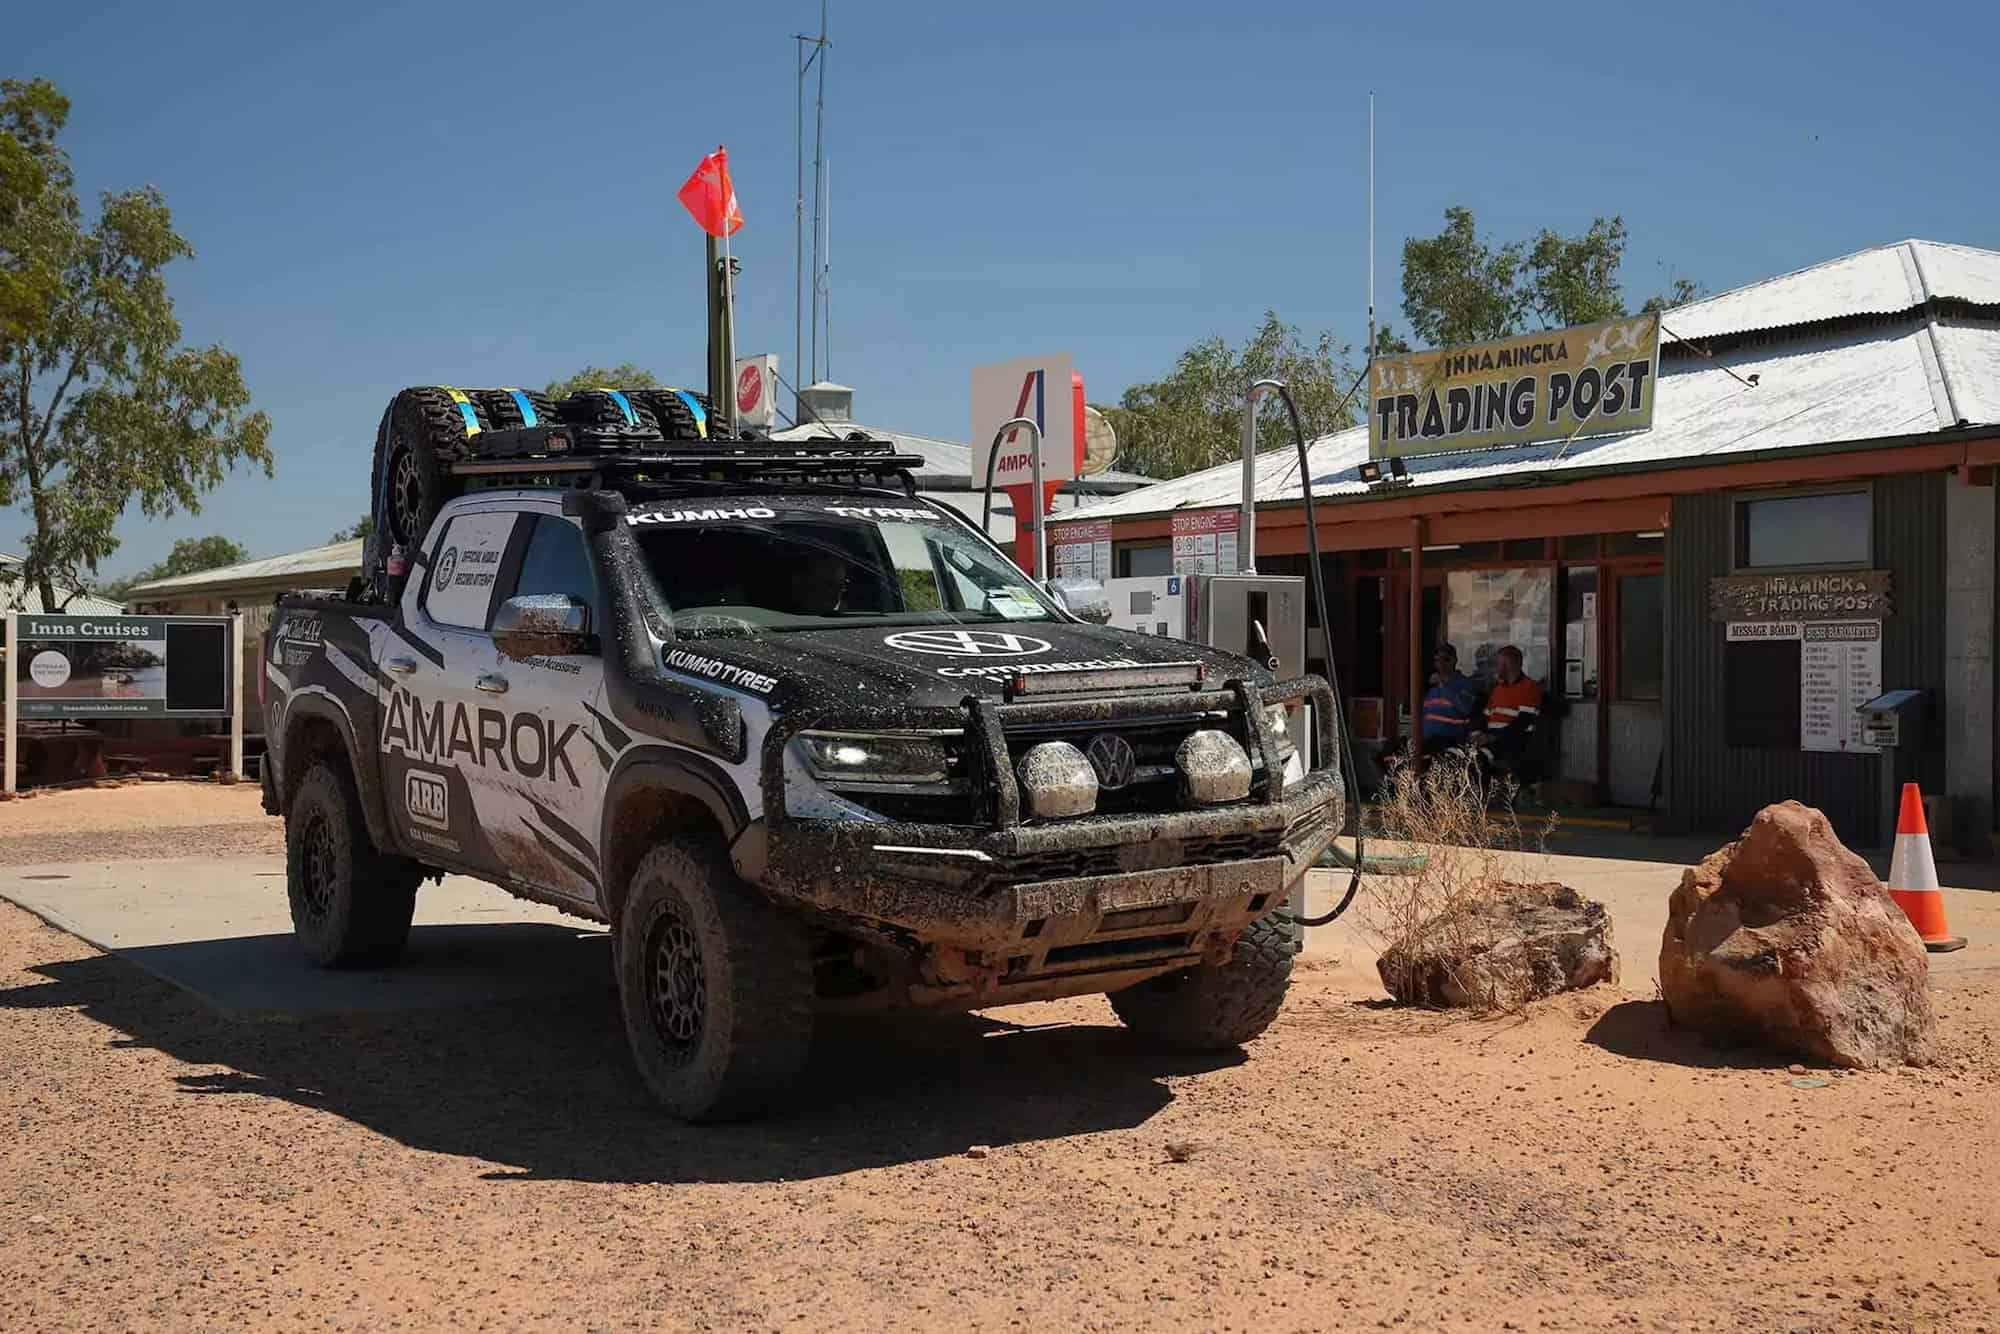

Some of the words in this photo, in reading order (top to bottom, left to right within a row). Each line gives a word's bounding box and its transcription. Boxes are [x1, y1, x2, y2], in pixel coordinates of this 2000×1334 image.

[1446, 340, 1568, 378] INNAMINCKA
[1376, 375, 1536, 441] TRADING
[1547, 359, 1651, 423] POST
[625, 507, 776, 526] KUMHO
[824, 506, 941, 520] TYRES
[30, 621, 75, 636] Inna
[80, 622, 149, 637] Cruises
[383, 690, 583, 788] AMAROK
[409, 778, 444, 820] ARB
